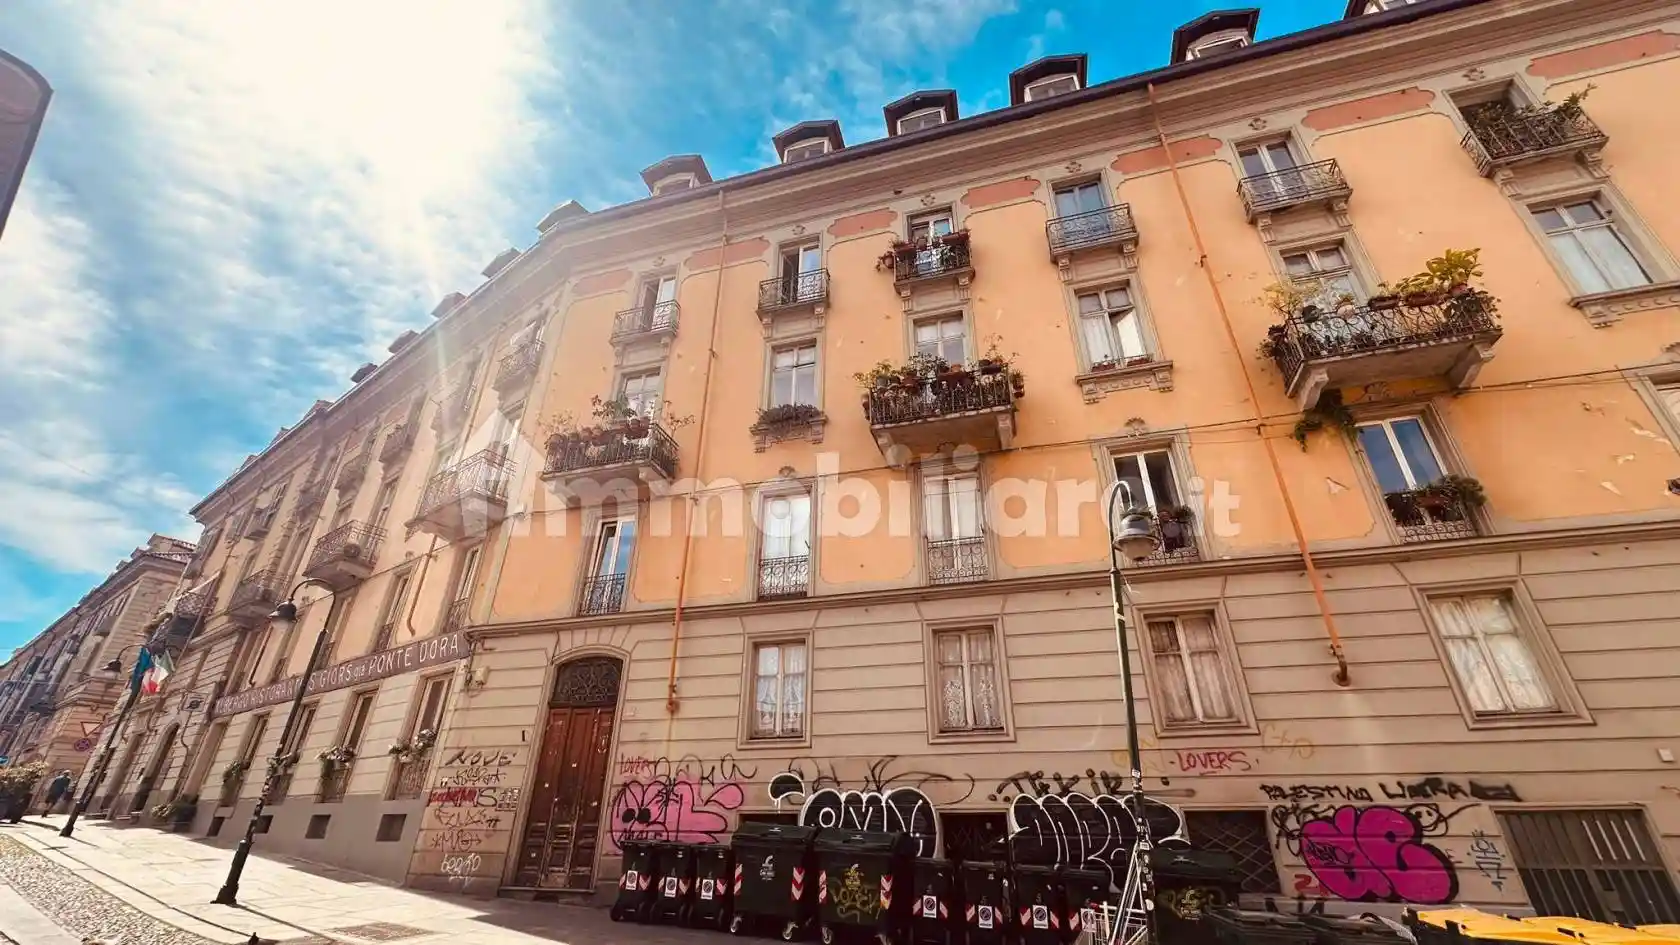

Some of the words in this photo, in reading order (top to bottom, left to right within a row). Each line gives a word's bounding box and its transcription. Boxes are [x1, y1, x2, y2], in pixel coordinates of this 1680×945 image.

[250, 678, 305, 705] RISTORANT
[367, 646, 414, 675] PONTE
[419, 634, 460, 664] DORA
[1176, 750, 1252, 774] LOVERS
